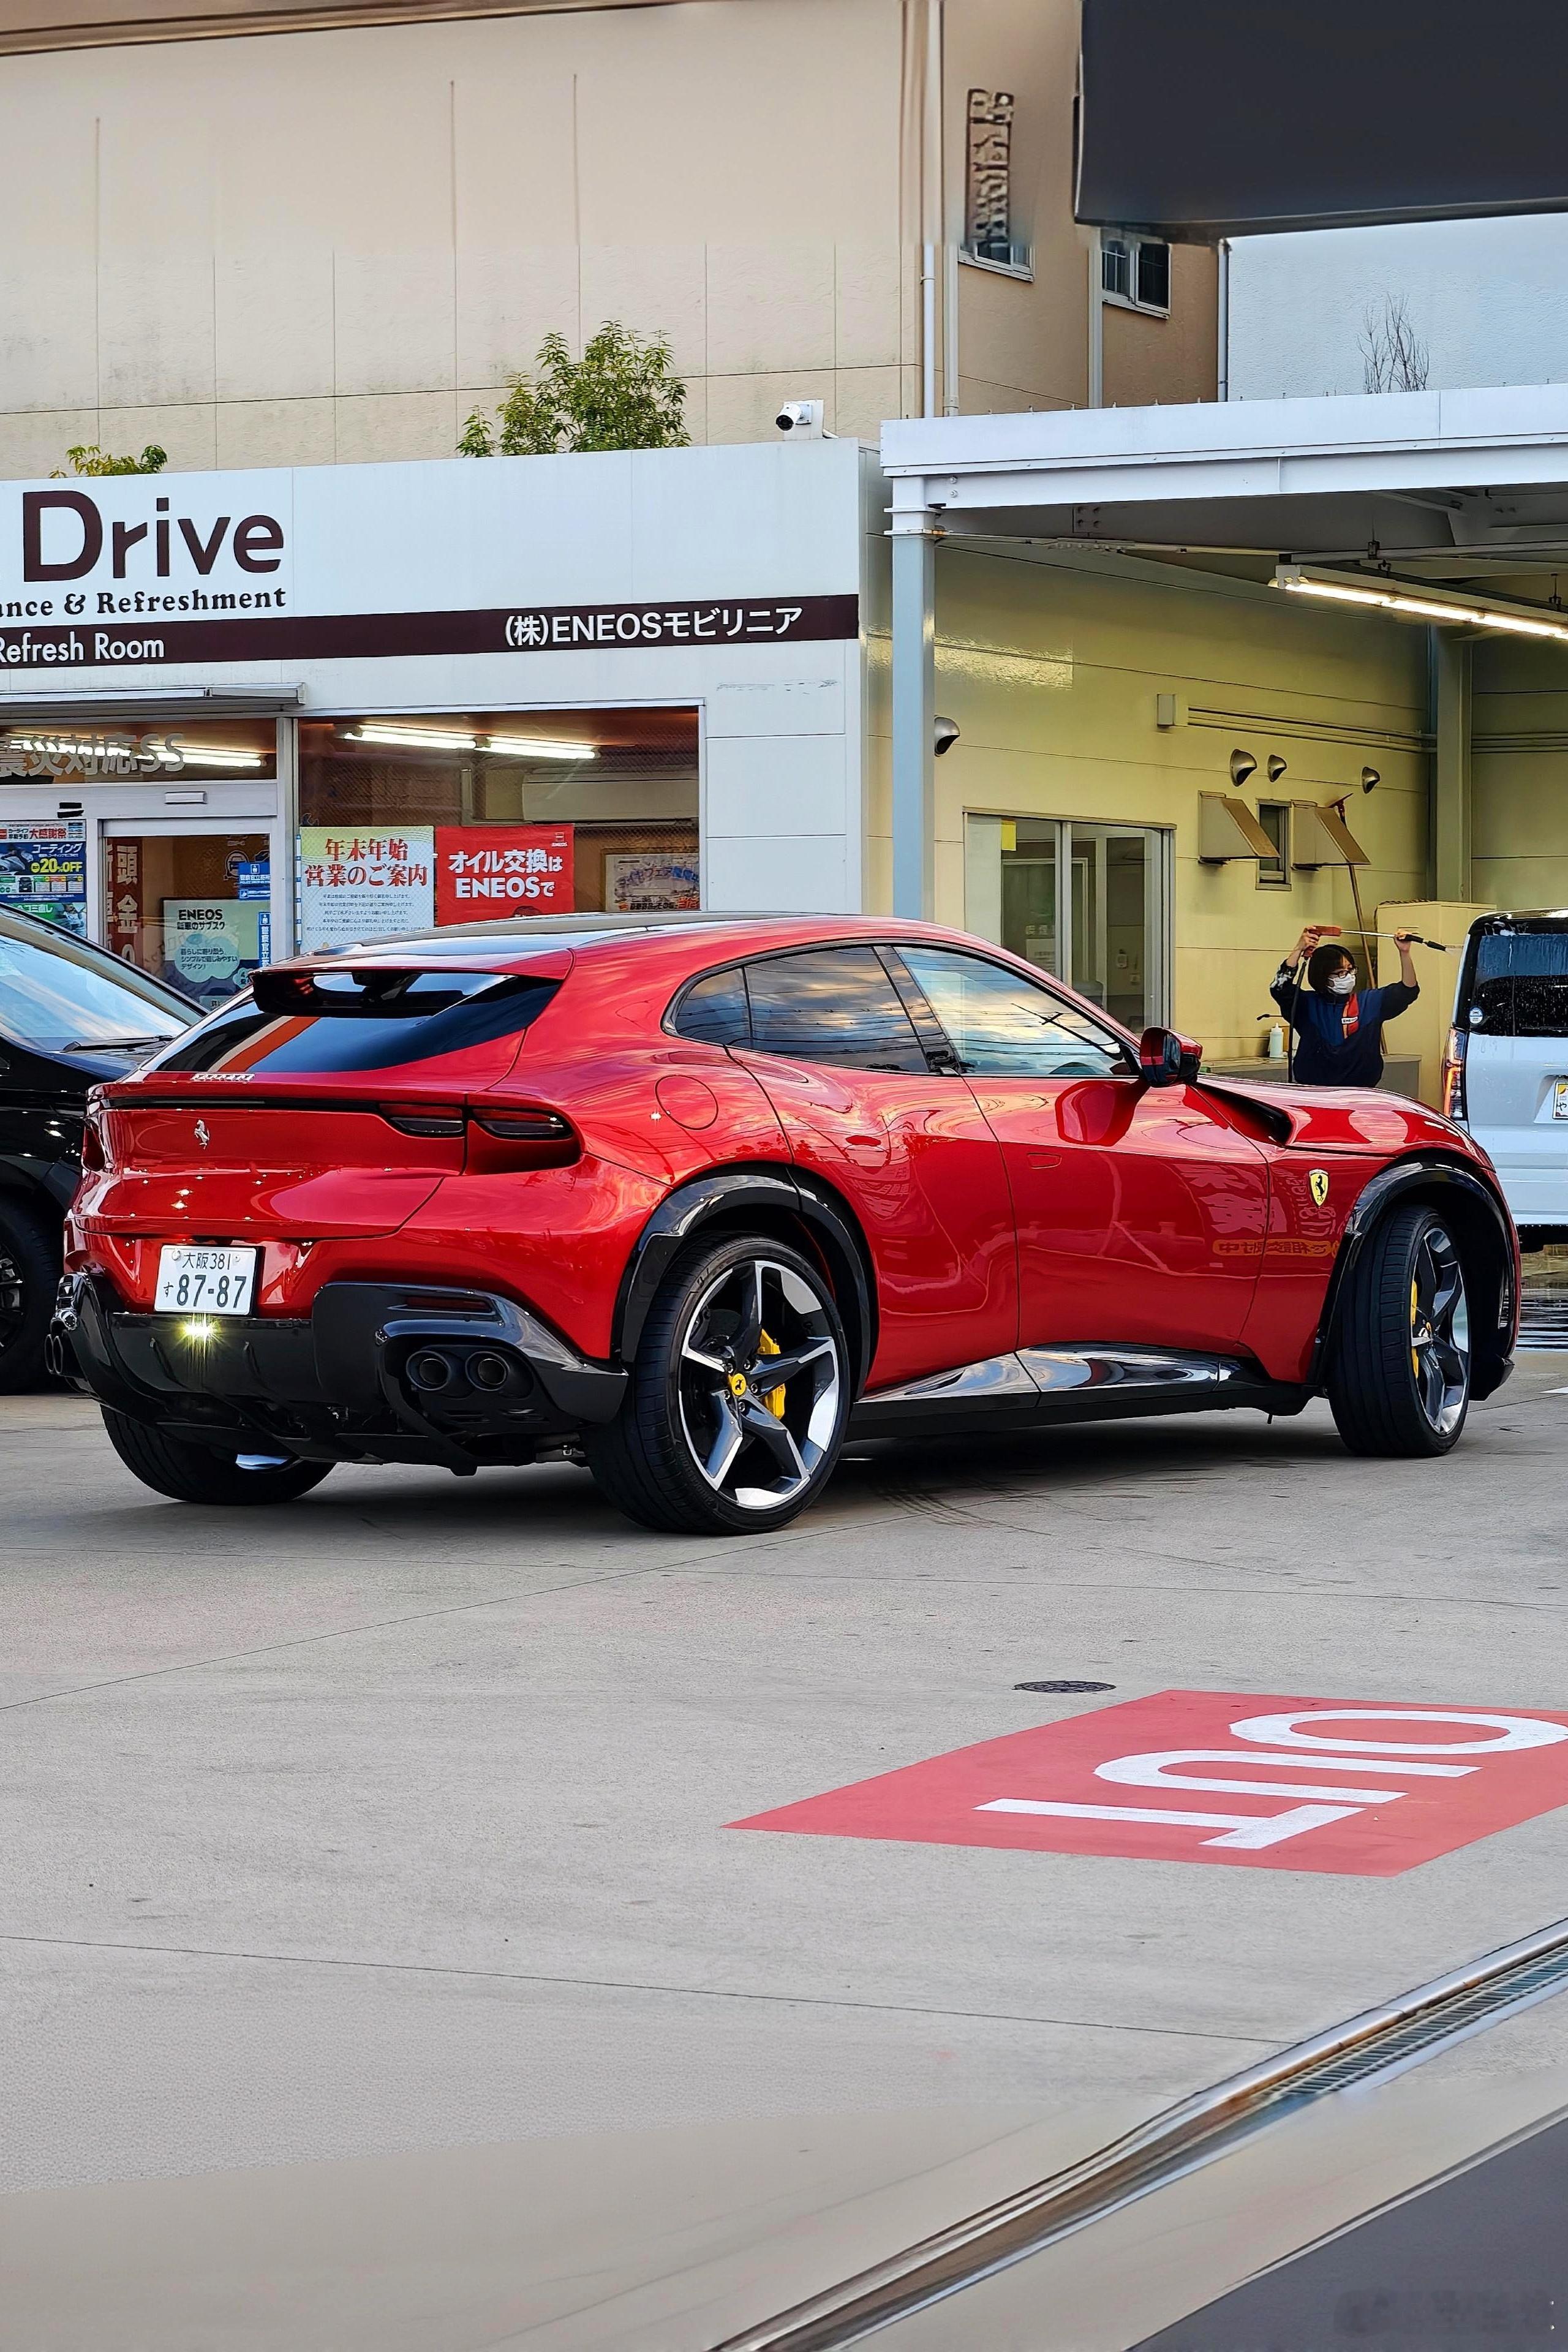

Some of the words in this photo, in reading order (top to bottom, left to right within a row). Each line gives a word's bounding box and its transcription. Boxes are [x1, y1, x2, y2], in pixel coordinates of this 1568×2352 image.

[23, 490, 284, 582] Drive
[0, 601, 53, 617] nce
[64, 593, 86, 614] &
[97, 588, 287, 614] Refreshment
[505, 607, 802, 646] (株)ENEOSモビリニア
[95, 633, 165, 660] Room
[31, 843, 83, 853] コーティング
[325, 839, 409, 861] 年末年始
[448, 849, 563, 874] オイル交換は
[305, 864, 428, 888] 営業のご案内
[456, 876, 555, 898] ENEOSで
[178, 909, 223, 921] ENEOS
[176, 1274, 247, 1308] 87-87
[973, 1709, 1568, 1850] OUT
